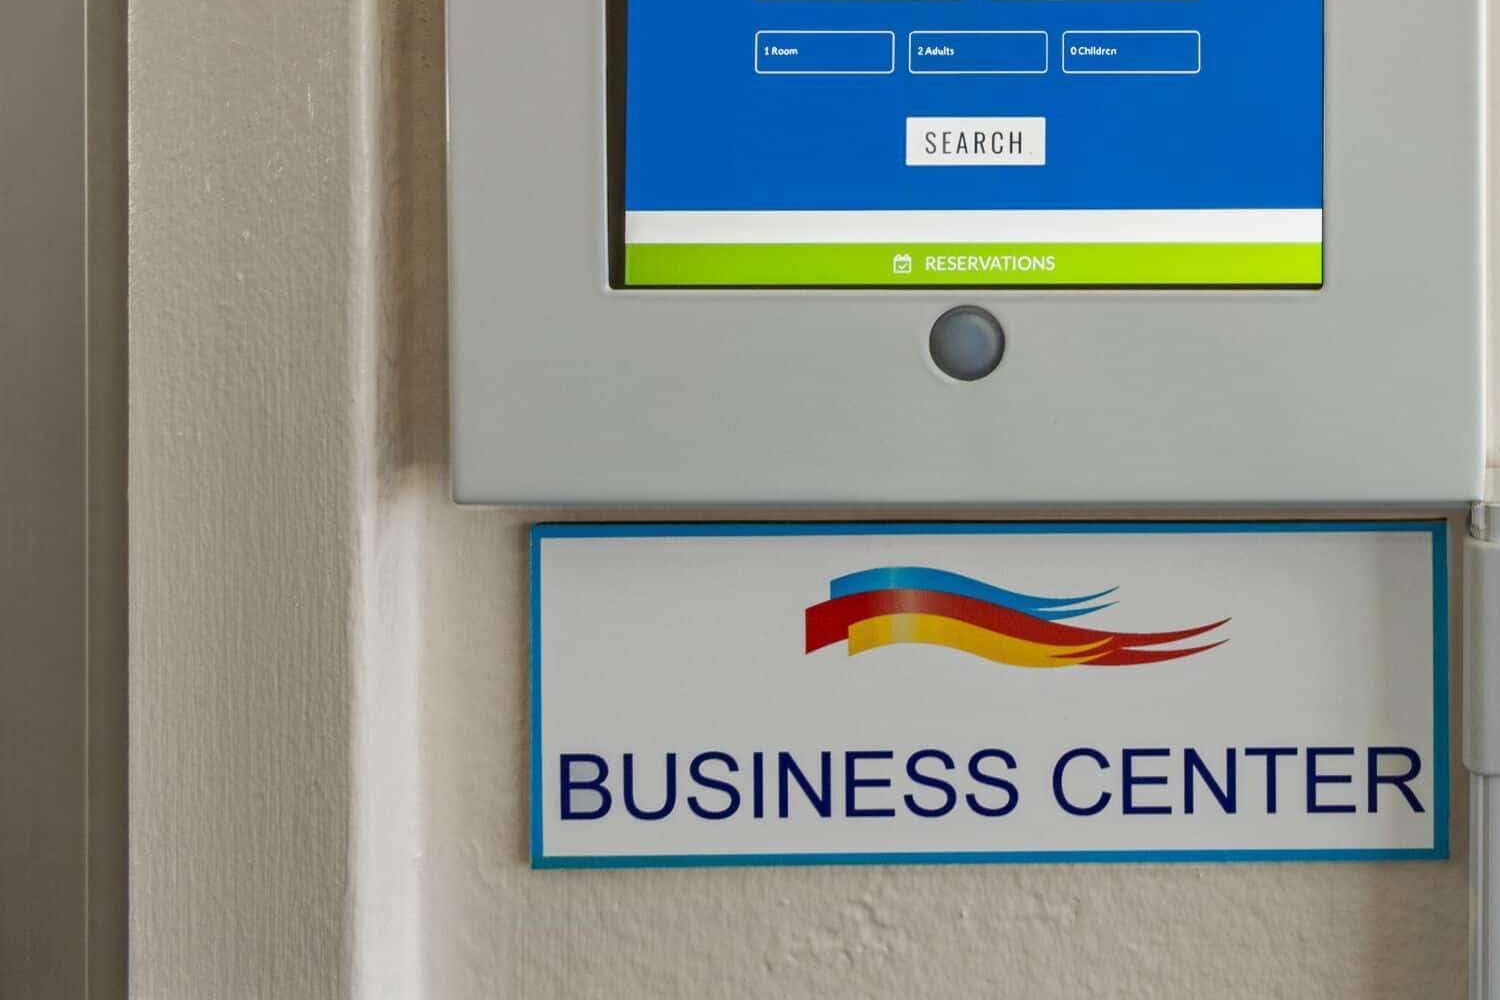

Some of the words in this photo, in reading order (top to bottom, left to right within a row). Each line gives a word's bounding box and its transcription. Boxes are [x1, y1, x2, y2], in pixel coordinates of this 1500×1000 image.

[764, 47, 769, 56] 1
[771, 46, 798, 56] Room
[917, 46, 923, 56] 2
[925, 46, 954, 56] Adults
[1070, 46, 1077, 56] 0
[1078, 46, 1117, 56] Children
[924, 131, 1023, 154] SEARCH
[925, 255, 1055, 271] RESERVATIONS
[557, 748, 1020, 822] BUSINESS
[1050, 745, 1427, 818] CENTER
